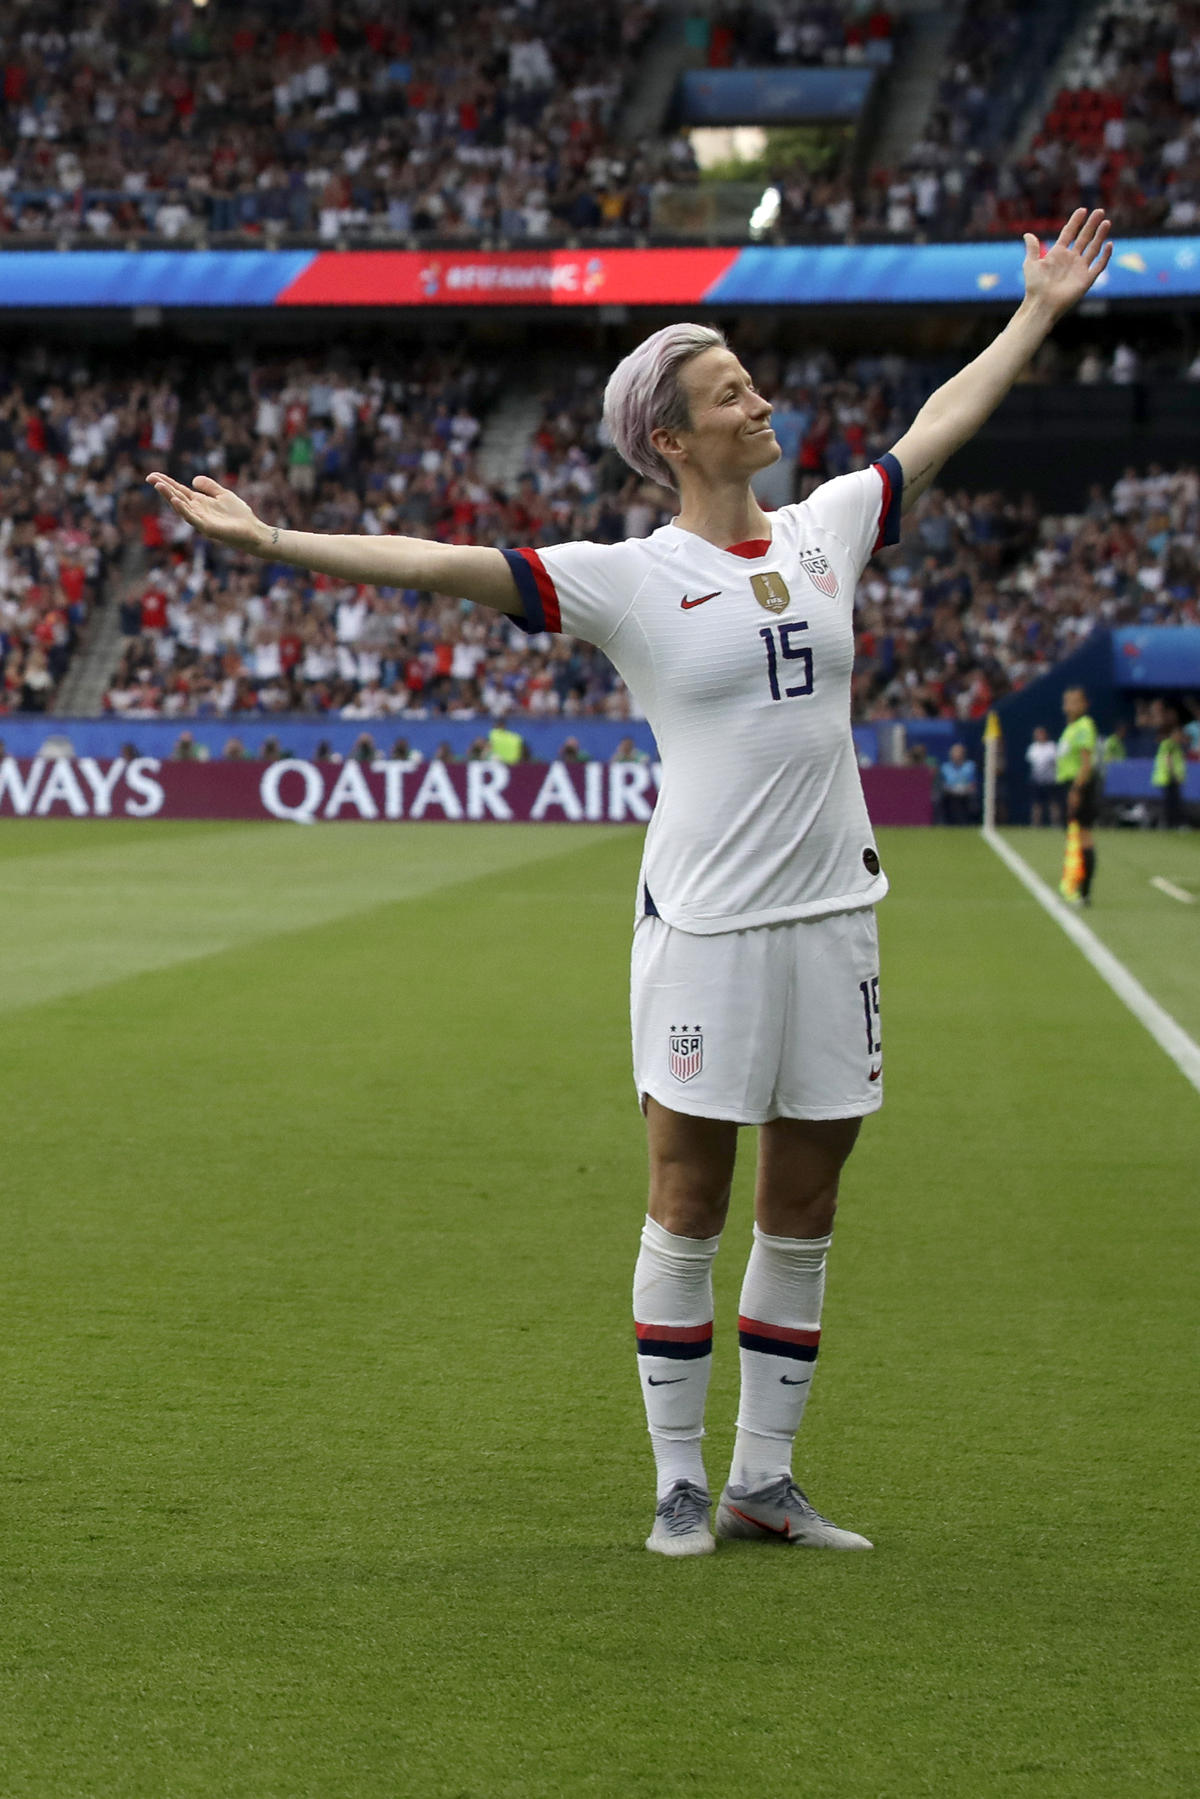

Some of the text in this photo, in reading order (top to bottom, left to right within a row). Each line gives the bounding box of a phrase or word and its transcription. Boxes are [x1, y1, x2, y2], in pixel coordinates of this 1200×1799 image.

[759, 621, 814, 701] 15
[259, 758, 662, 825] QATAR AIR
[671, 1038, 700, 1056] USA
